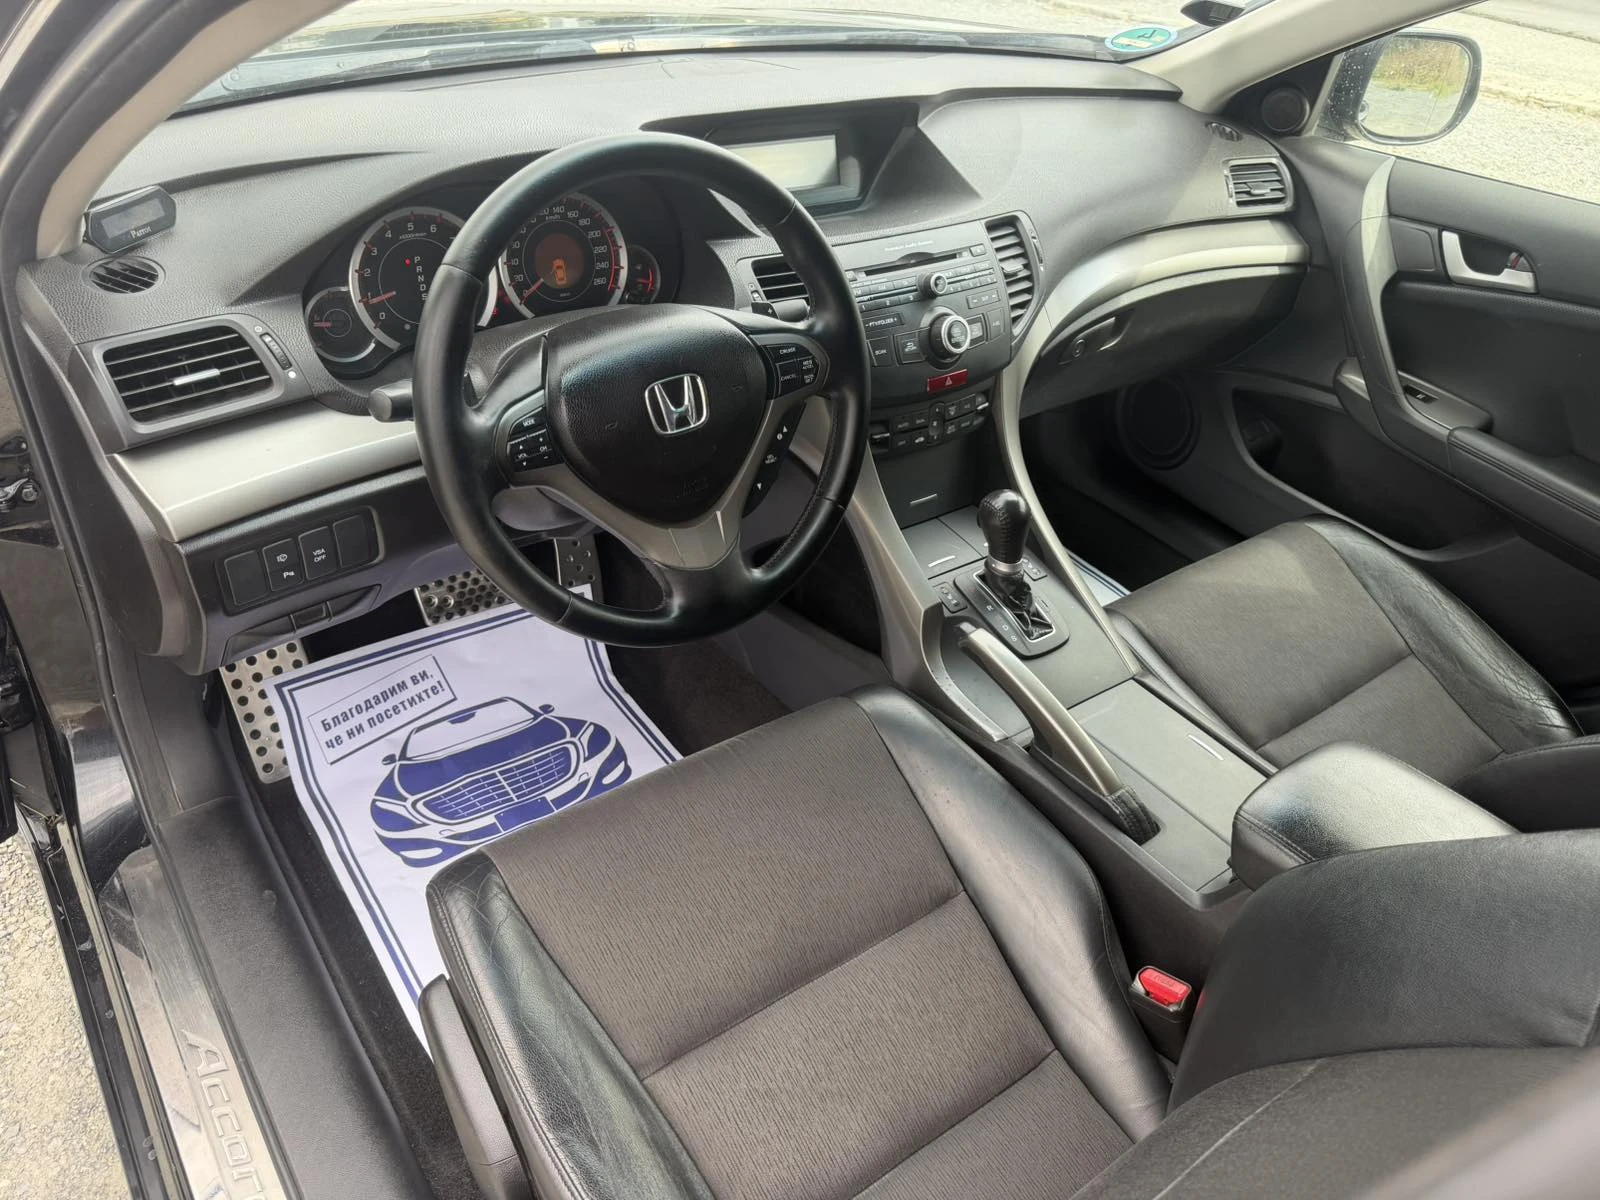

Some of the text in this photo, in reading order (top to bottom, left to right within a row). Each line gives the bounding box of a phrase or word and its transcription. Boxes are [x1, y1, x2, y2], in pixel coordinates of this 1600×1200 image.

[408, 222, 414, 231] 5
[430, 224, 437, 233] 6
[385, 230, 392, 238] 4
[588, 230, 601, 238] 200
[371, 248, 378, 256] 3
[594, 245, 608, 253] 220
[414, 256, 421, 264] P
[416, 265, 422, 273] R
[596, 261, 609, 269] 240
[364, 268, 371, 277] 2
[420, 283, 426, 291] D
[379, 312, 385, 320] 0
[313, 554, 327, 563] OFF
[320, 668, 434, 733] Благодарим ви,
[325, 680, 446, 750] че ни посетихте!
